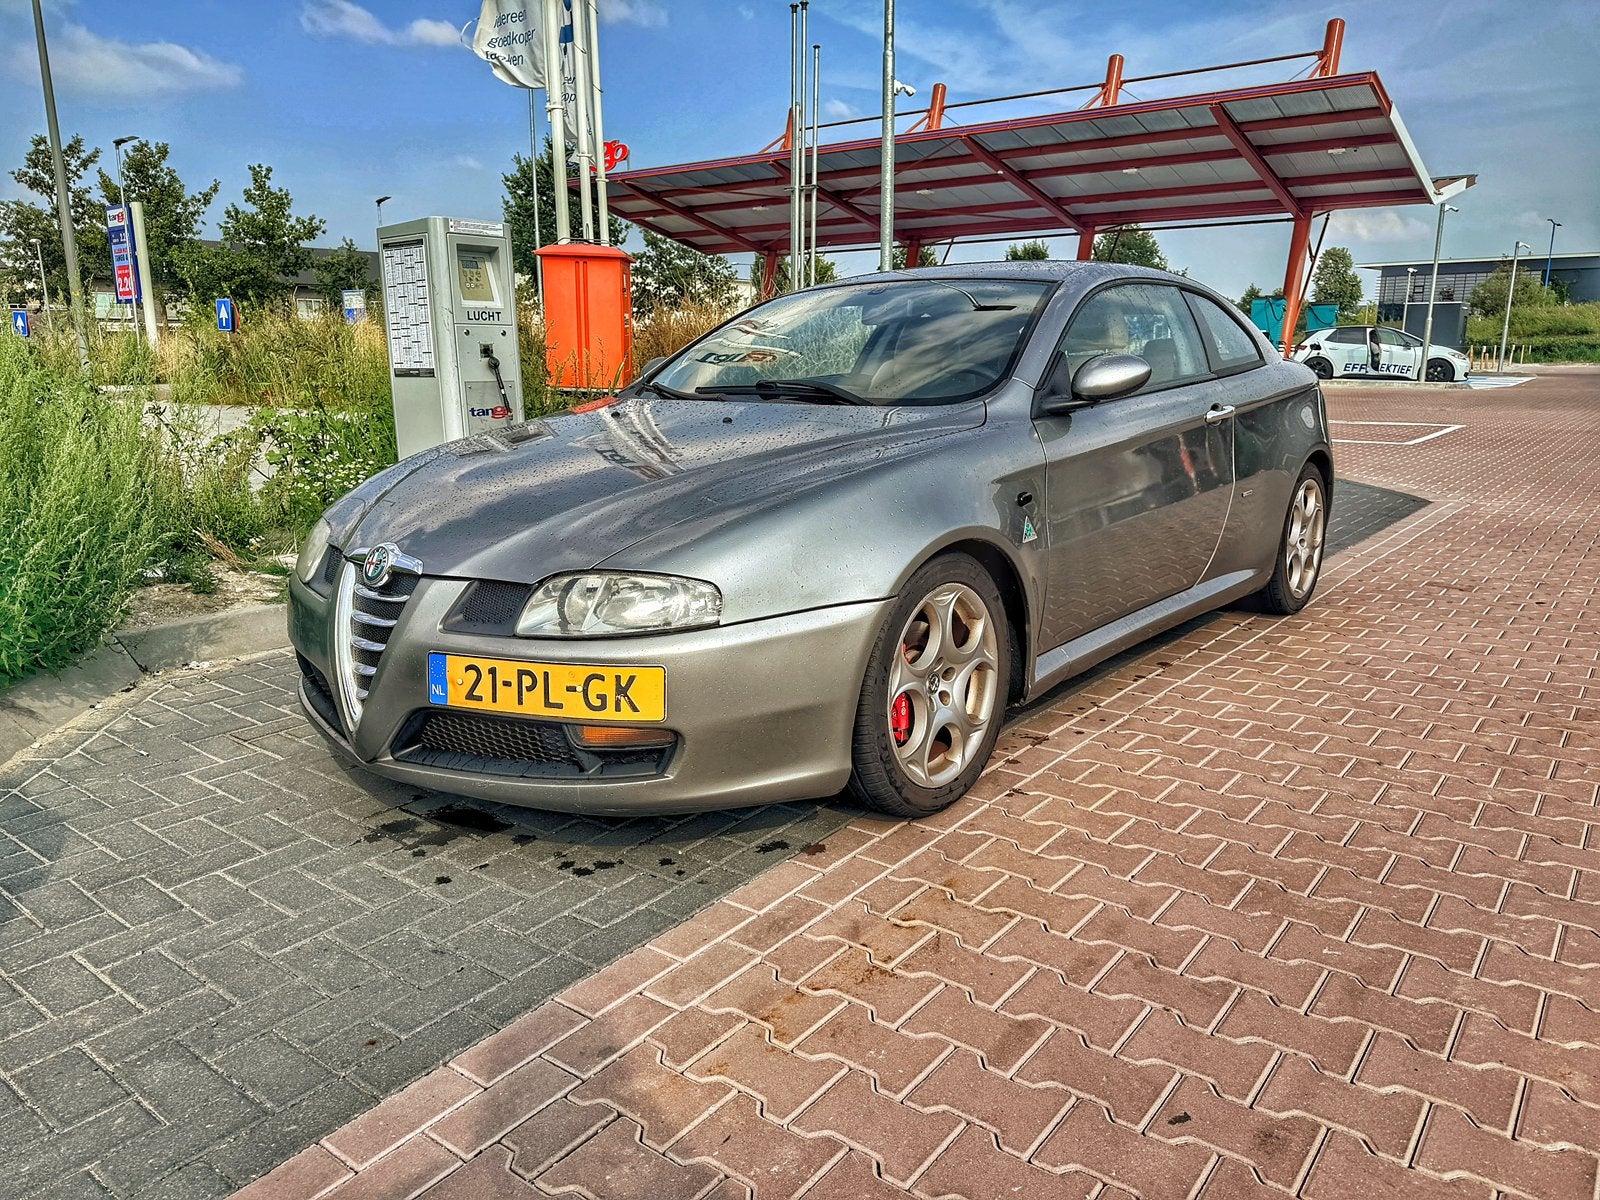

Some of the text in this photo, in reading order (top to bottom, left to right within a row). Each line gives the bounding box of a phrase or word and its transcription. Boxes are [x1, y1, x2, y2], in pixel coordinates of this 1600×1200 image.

[487, 29, 536, 48] goedkoper
[467, 310, 502, 322] LUCHT
[431, 683, 446, 697] NL
[464, 663, 641, 713] 21-PL-GK
